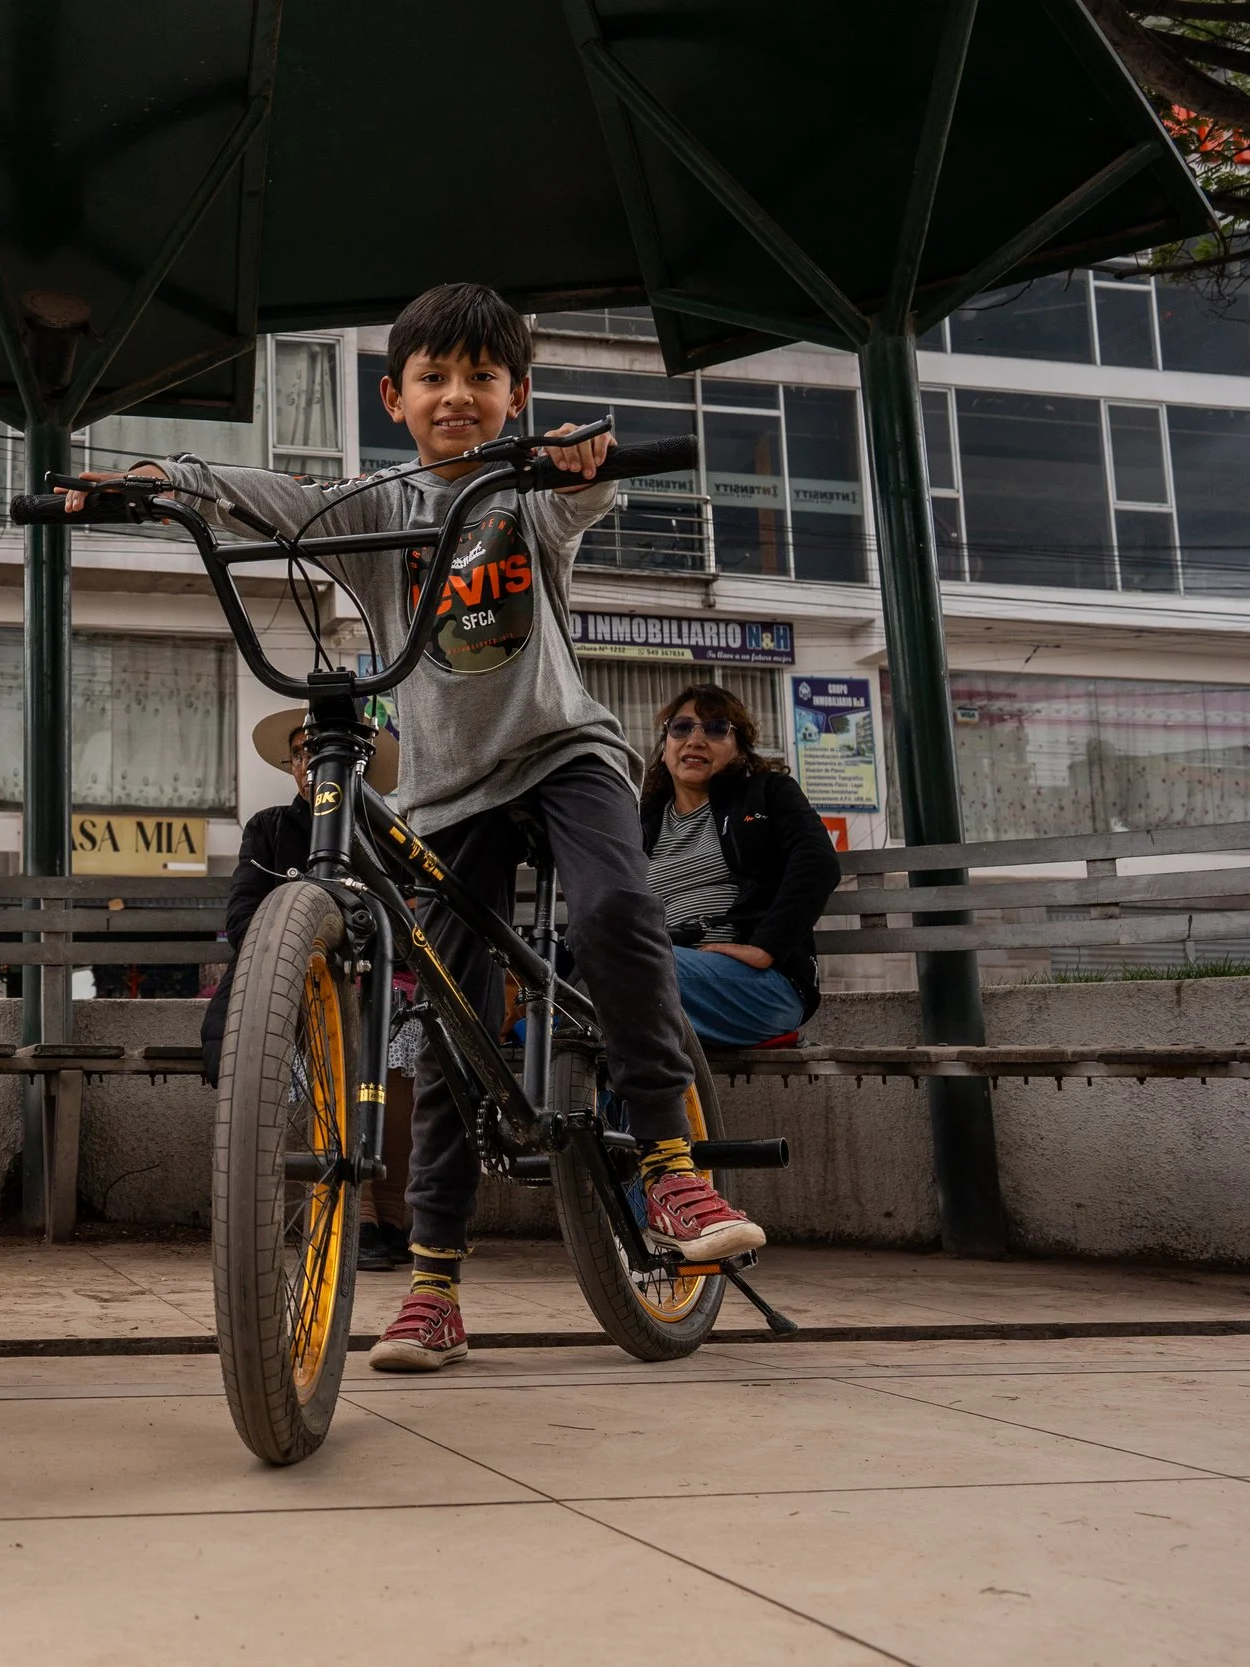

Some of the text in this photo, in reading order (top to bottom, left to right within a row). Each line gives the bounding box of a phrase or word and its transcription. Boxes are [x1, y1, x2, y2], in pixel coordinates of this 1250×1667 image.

[461, 609, 496, 631] SFCA
[588, 614, 742, 649] INMOBILIARIO
[746, 623, 790, 650] N&H
[315, 791, 338, 807] BK
[72, 819, 197, 855] SA MIA
